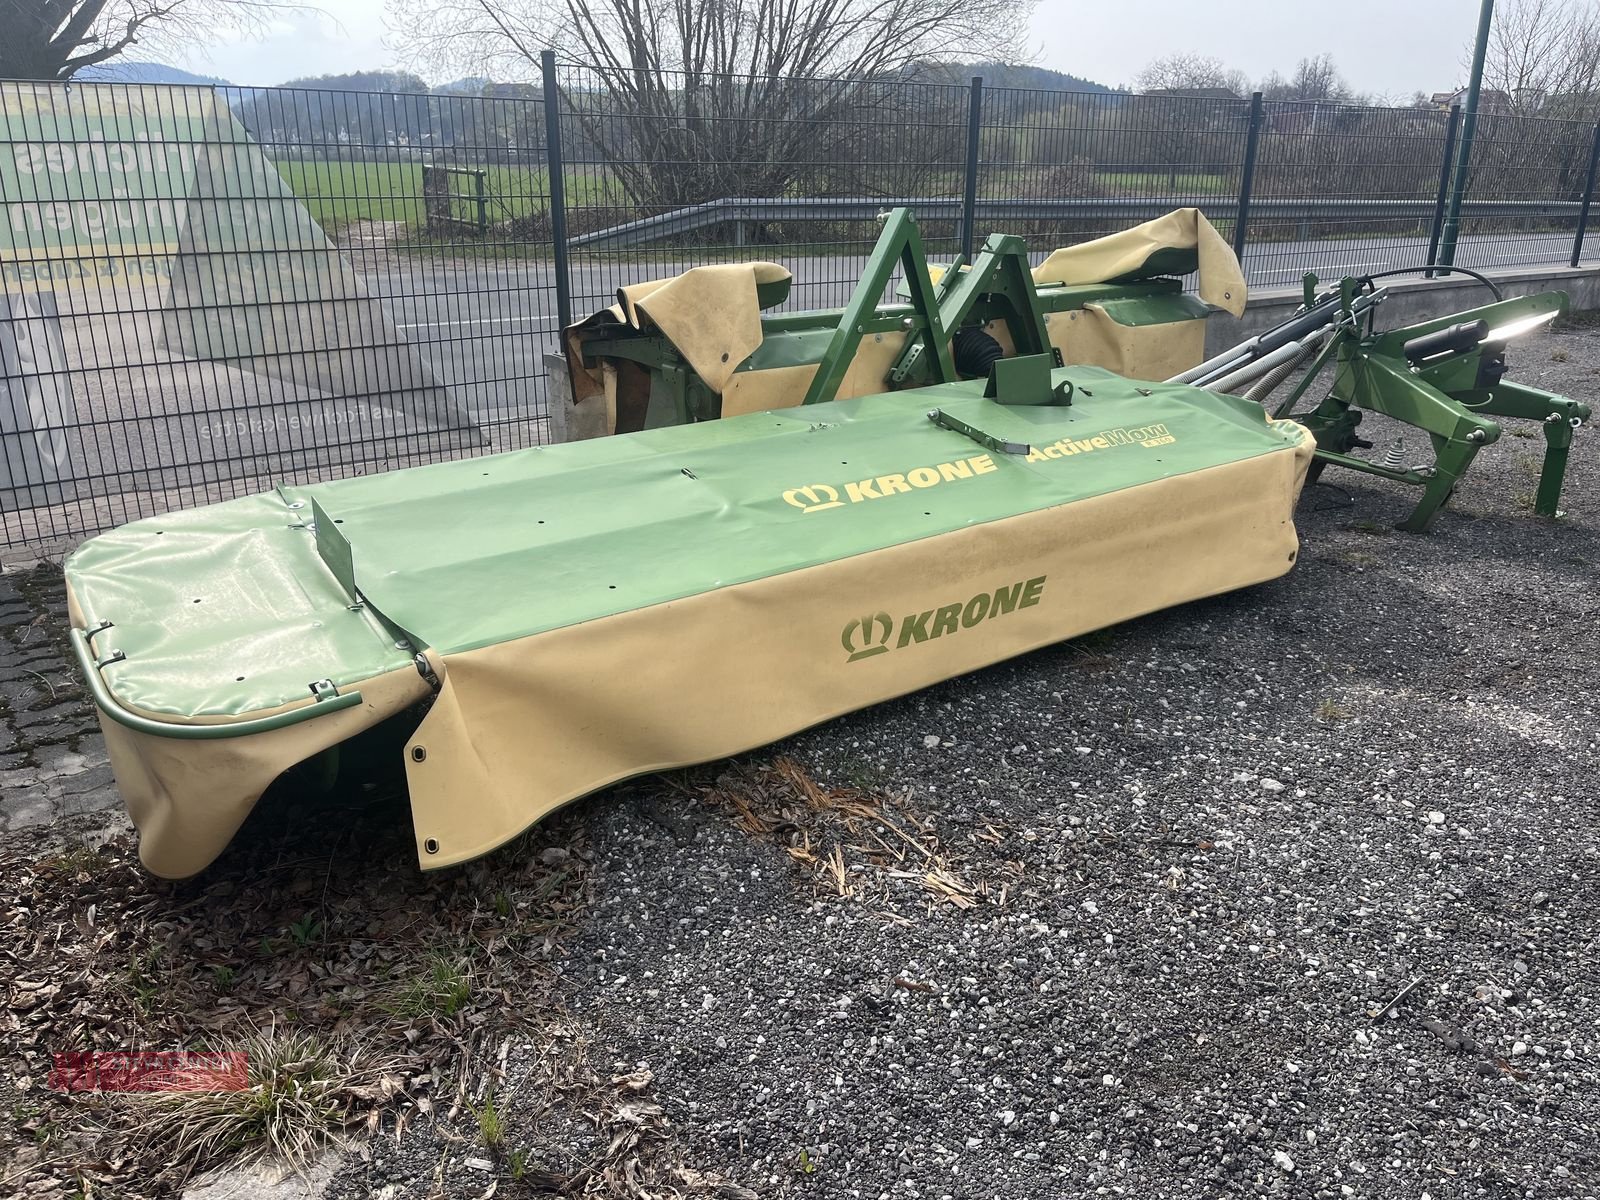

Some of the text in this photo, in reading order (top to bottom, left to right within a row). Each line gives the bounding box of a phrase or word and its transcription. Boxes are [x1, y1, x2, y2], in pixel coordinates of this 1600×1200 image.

[1025, 424, 1170, 463] ActiveMow
[844, 454, 998, 503] KRONE
[896, 575, 1046, 649] KRONE
